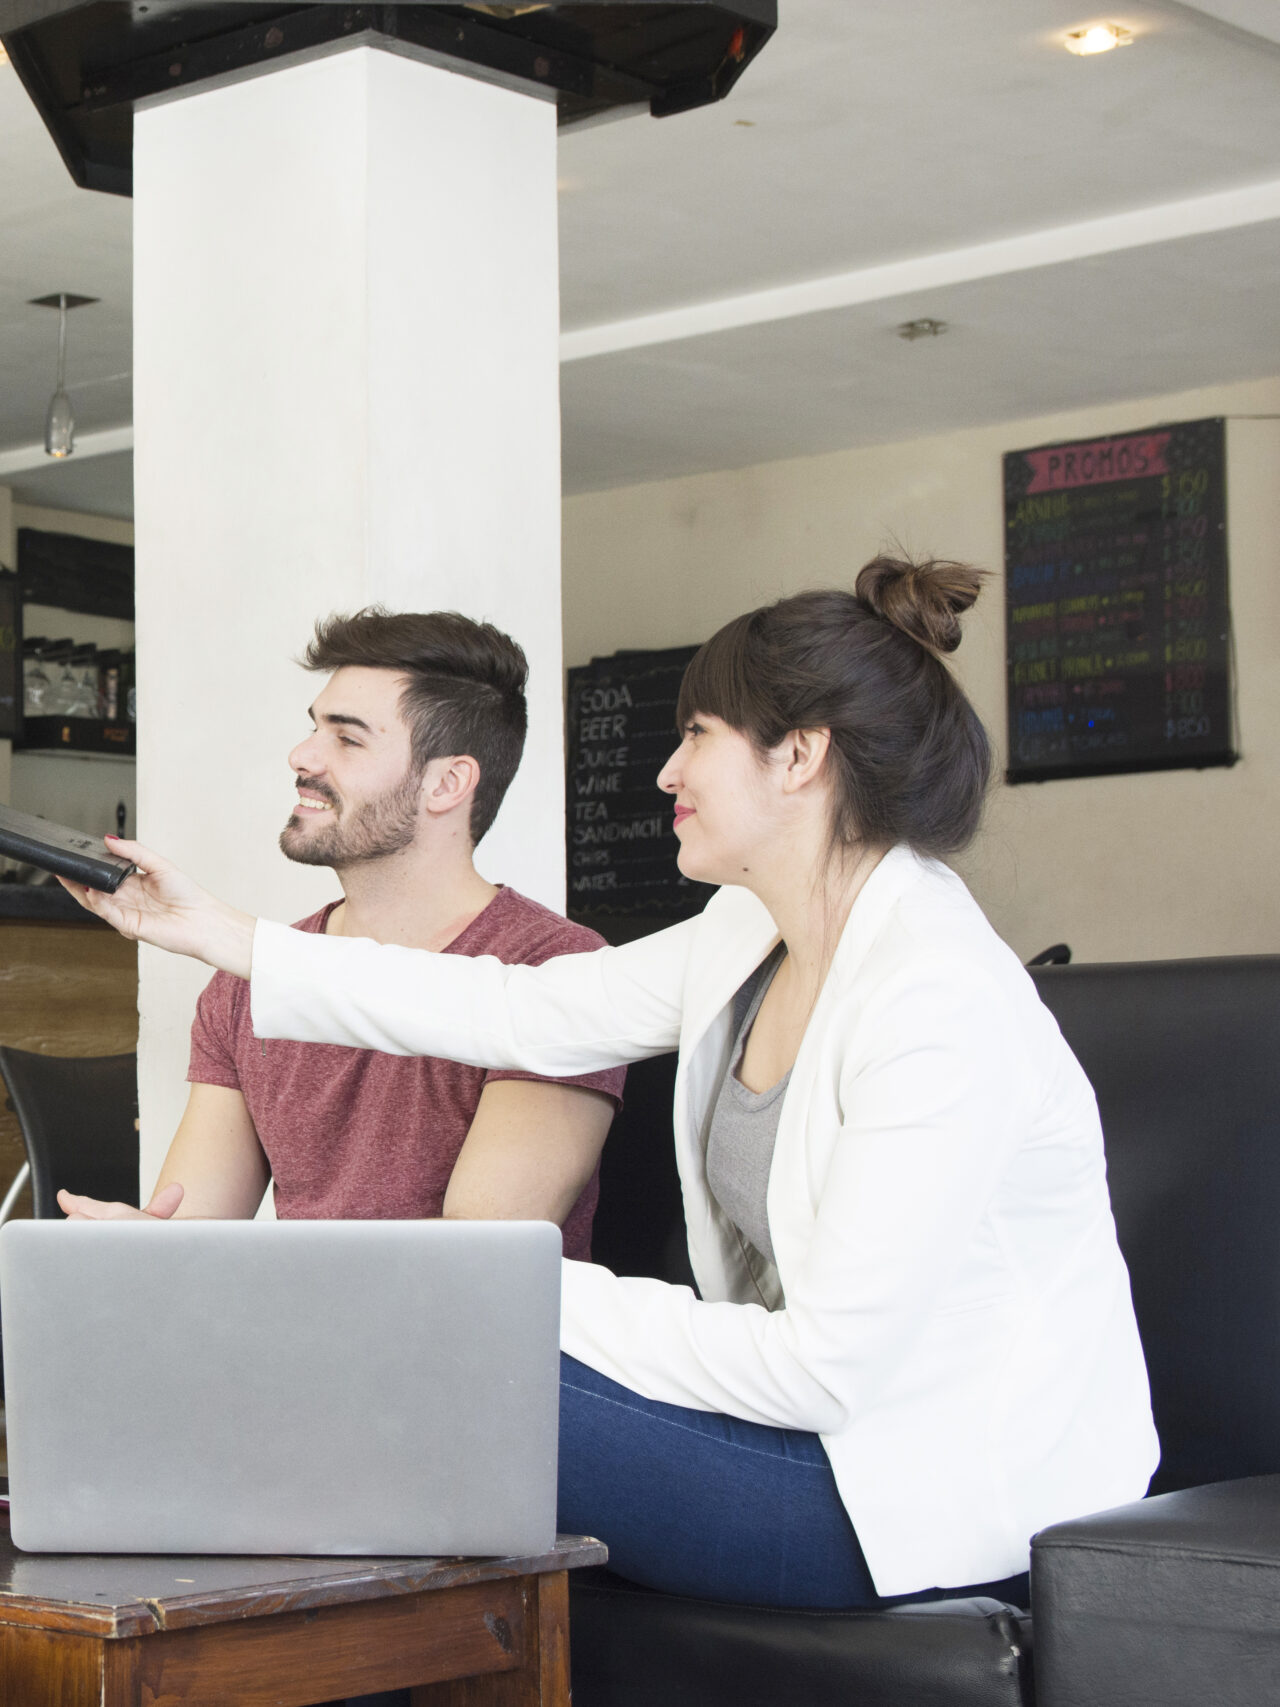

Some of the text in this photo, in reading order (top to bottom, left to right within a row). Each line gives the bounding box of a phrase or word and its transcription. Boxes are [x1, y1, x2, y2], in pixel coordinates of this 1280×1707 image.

[1047, 441, 1150, 483] PROMOS
[581, 684, 632, 714] SODA
[580, 714, 627, 742] BEER
[576, 747, 629, 770] JUICE
[575, 772, 622, 795] WINE
[575, 801, 608, 821] TEA
[573, 818, 662, 845] SANDWICH
[573, 871, 618, 891] WATER
